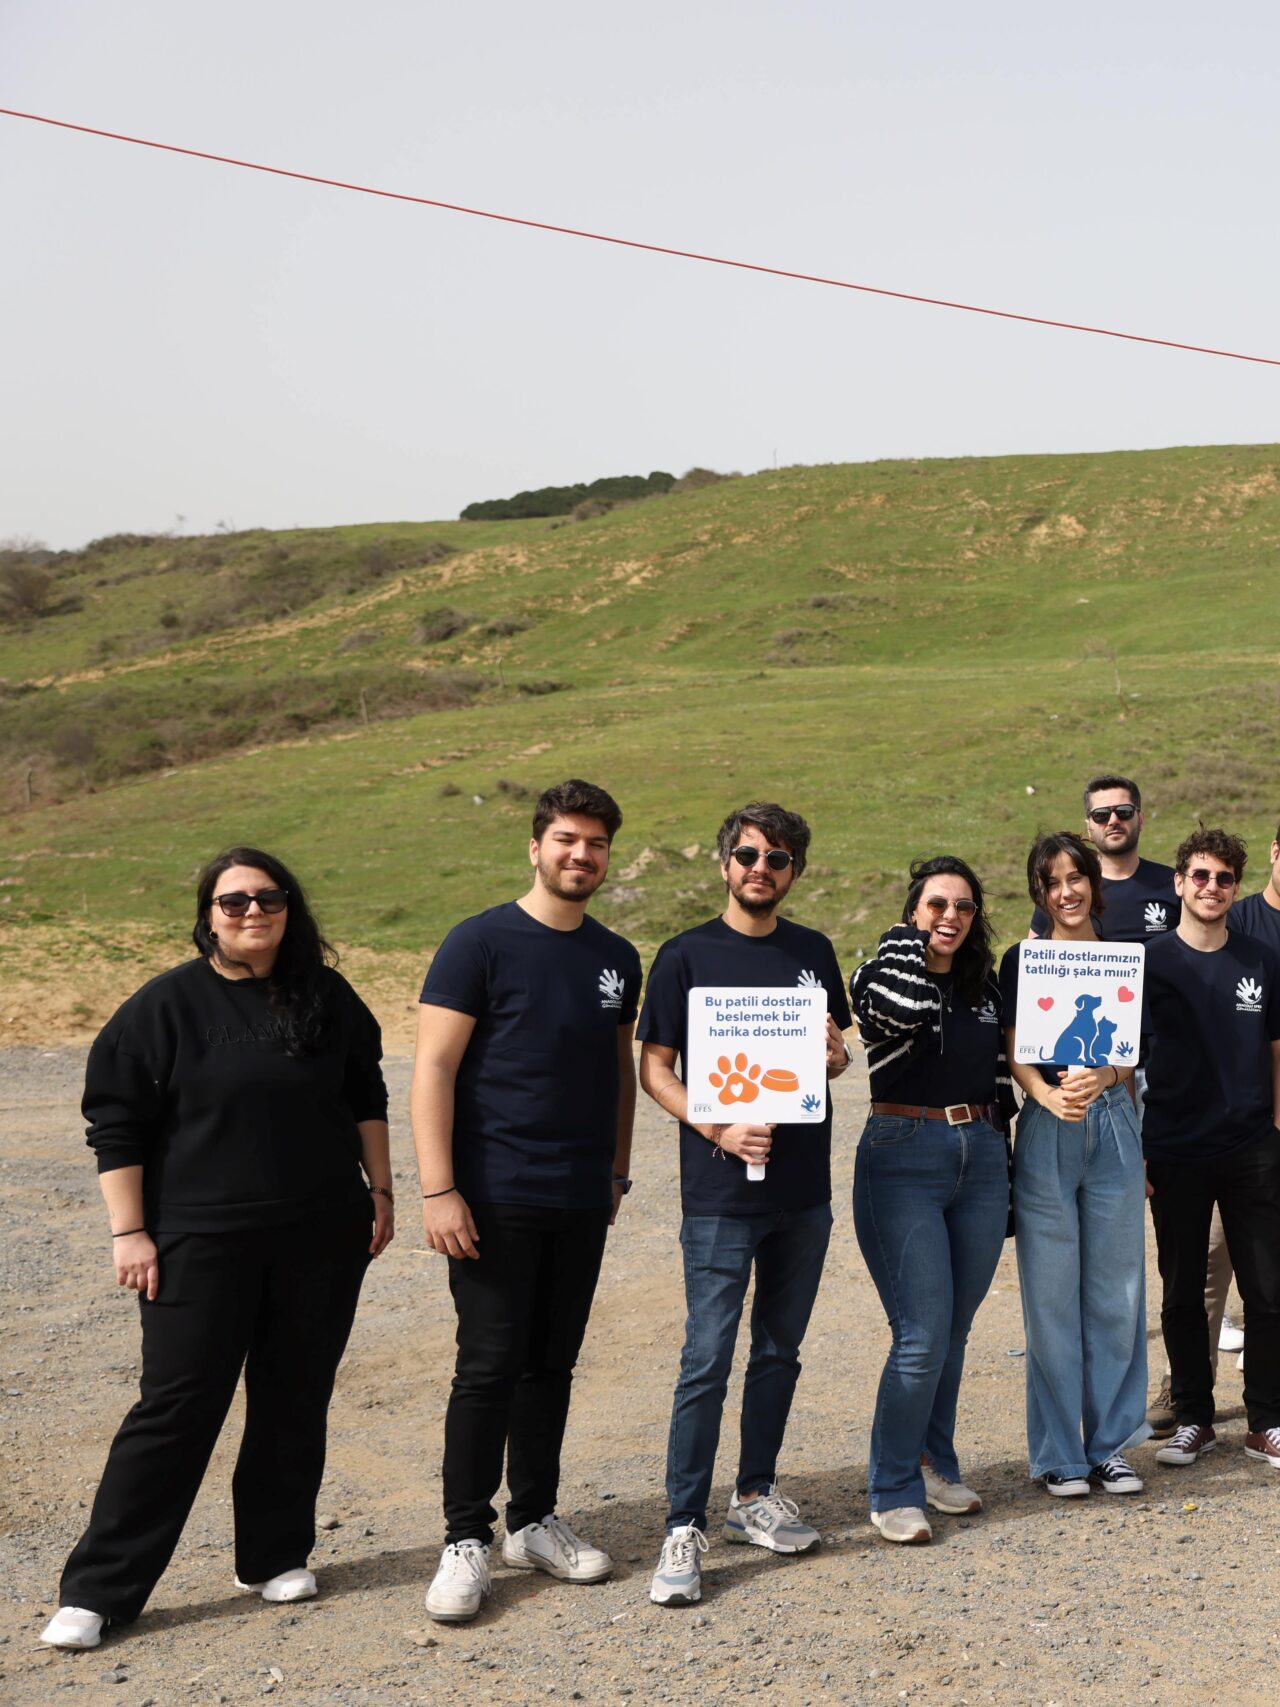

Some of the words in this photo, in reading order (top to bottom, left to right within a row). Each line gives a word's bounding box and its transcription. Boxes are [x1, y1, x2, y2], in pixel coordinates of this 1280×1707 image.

[1024, 950, 1055, 960] Patili
[1059, 950, 1141, 963] dostlarımızın
[1025, 965, 1070, 978] tatlılığı
[1073, 967, 1101, 978] şaka
[706, 997, 722, 1006] Bu
[726, 996, 758, 1009] patili
[762, 996, 811, 1006] dostları
[716, 1011, 780, 1022] beslemek
[783, 1012, 800, 1022] bir
[710, 1027, 749, 1037] harika
[753, 1026, 807, 1037] dostum!
